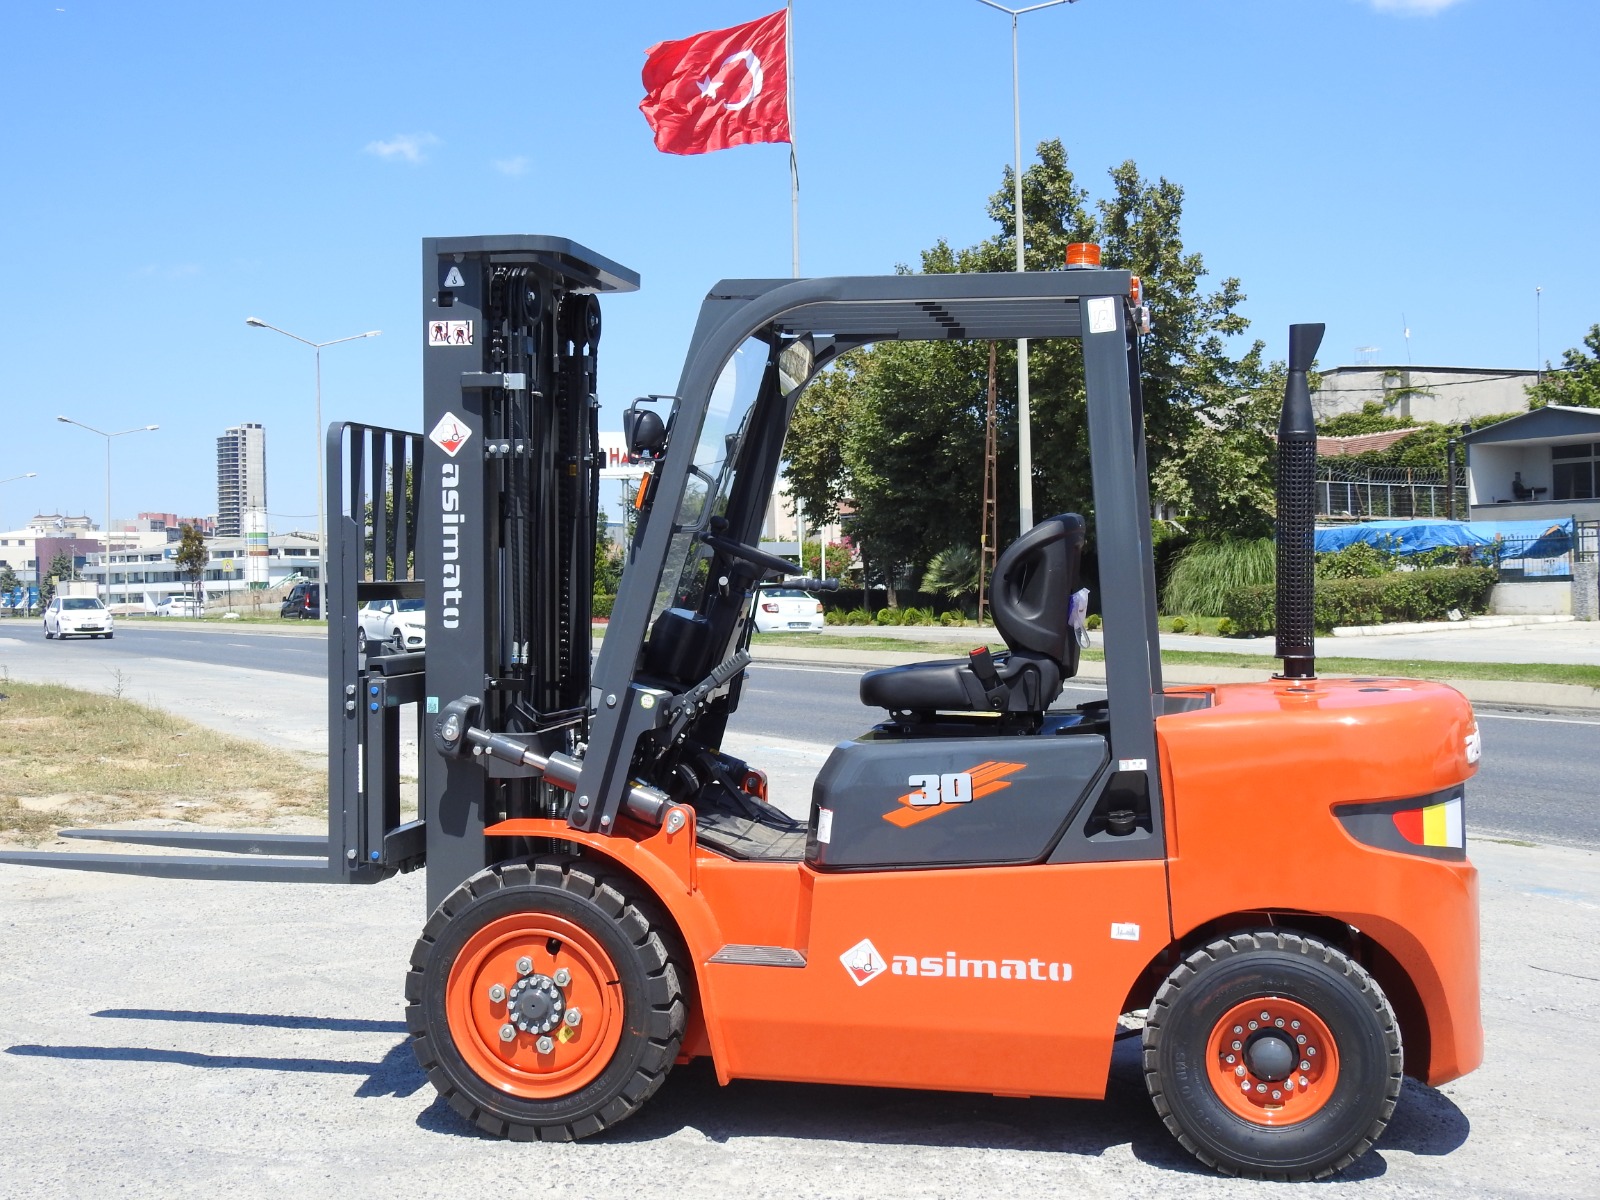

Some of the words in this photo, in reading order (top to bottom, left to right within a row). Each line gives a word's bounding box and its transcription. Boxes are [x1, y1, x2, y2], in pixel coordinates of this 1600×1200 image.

[442, 464, 465, 629] asimato
[908, 773, 973, 806] 30
[892, 951, 1073, 982] asimato
